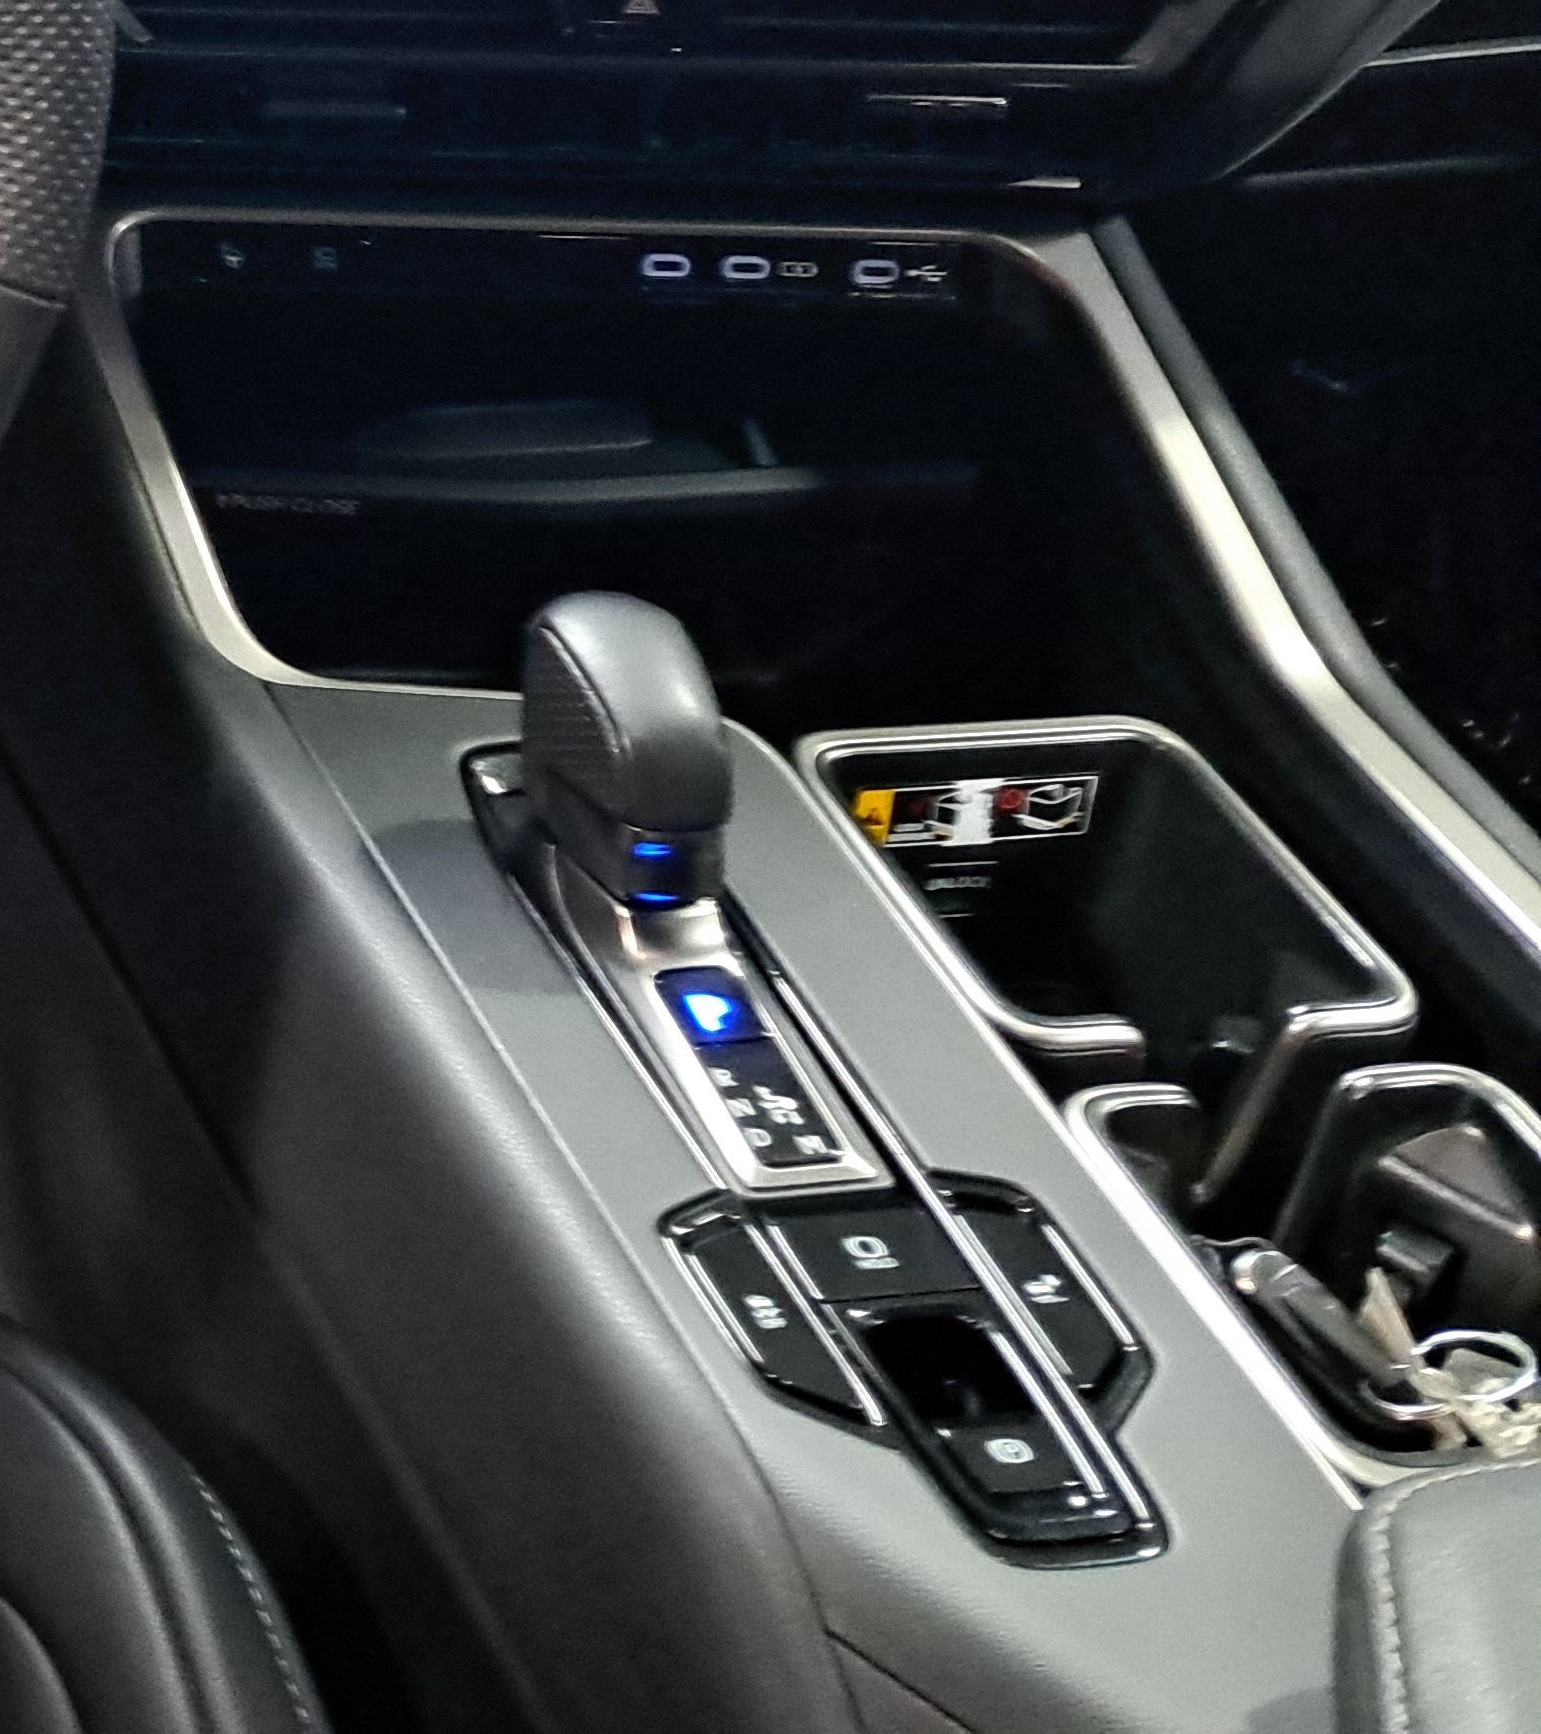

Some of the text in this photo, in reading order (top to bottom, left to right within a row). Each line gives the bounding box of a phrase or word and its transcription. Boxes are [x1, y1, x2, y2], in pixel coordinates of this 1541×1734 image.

[684, 993, 729, 1032] P
[725, 1097, 757, 1117] N
[744, 1127, 773, 1147] D
